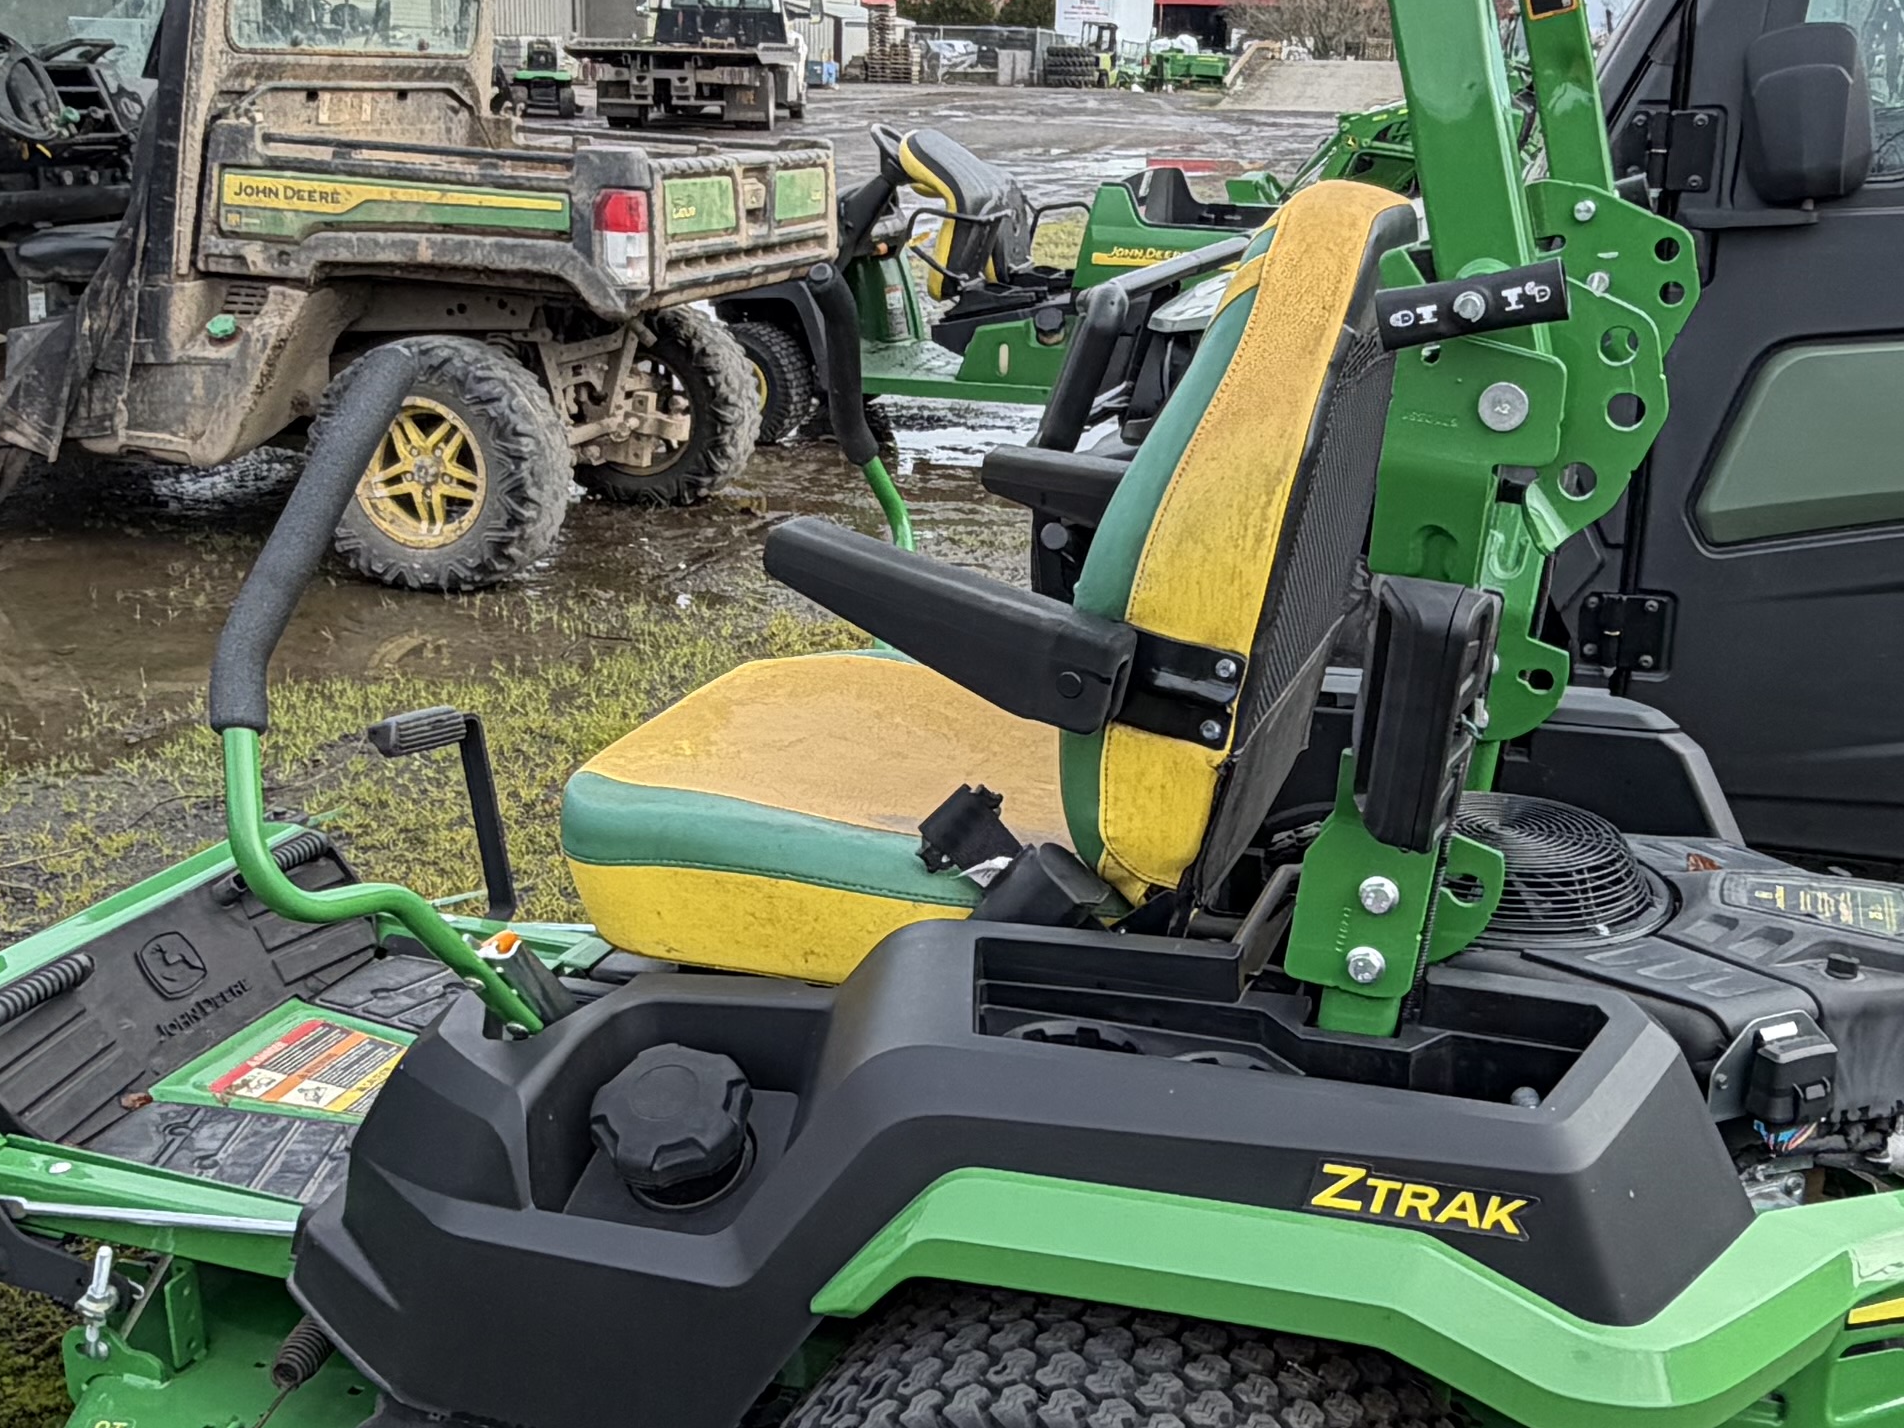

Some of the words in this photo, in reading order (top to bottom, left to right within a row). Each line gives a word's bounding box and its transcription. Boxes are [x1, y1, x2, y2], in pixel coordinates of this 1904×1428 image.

[233, 181, 279, 200] JOHN
[283, 185, 341, 204] DEERE
[1108, 246, 1143, 259] JOHN
[156, 1007, 201, 1043] JOHN
[195, 979, 253, 1017] DEERE
[1311, 1163, 1529, 1234] ZTRAK
